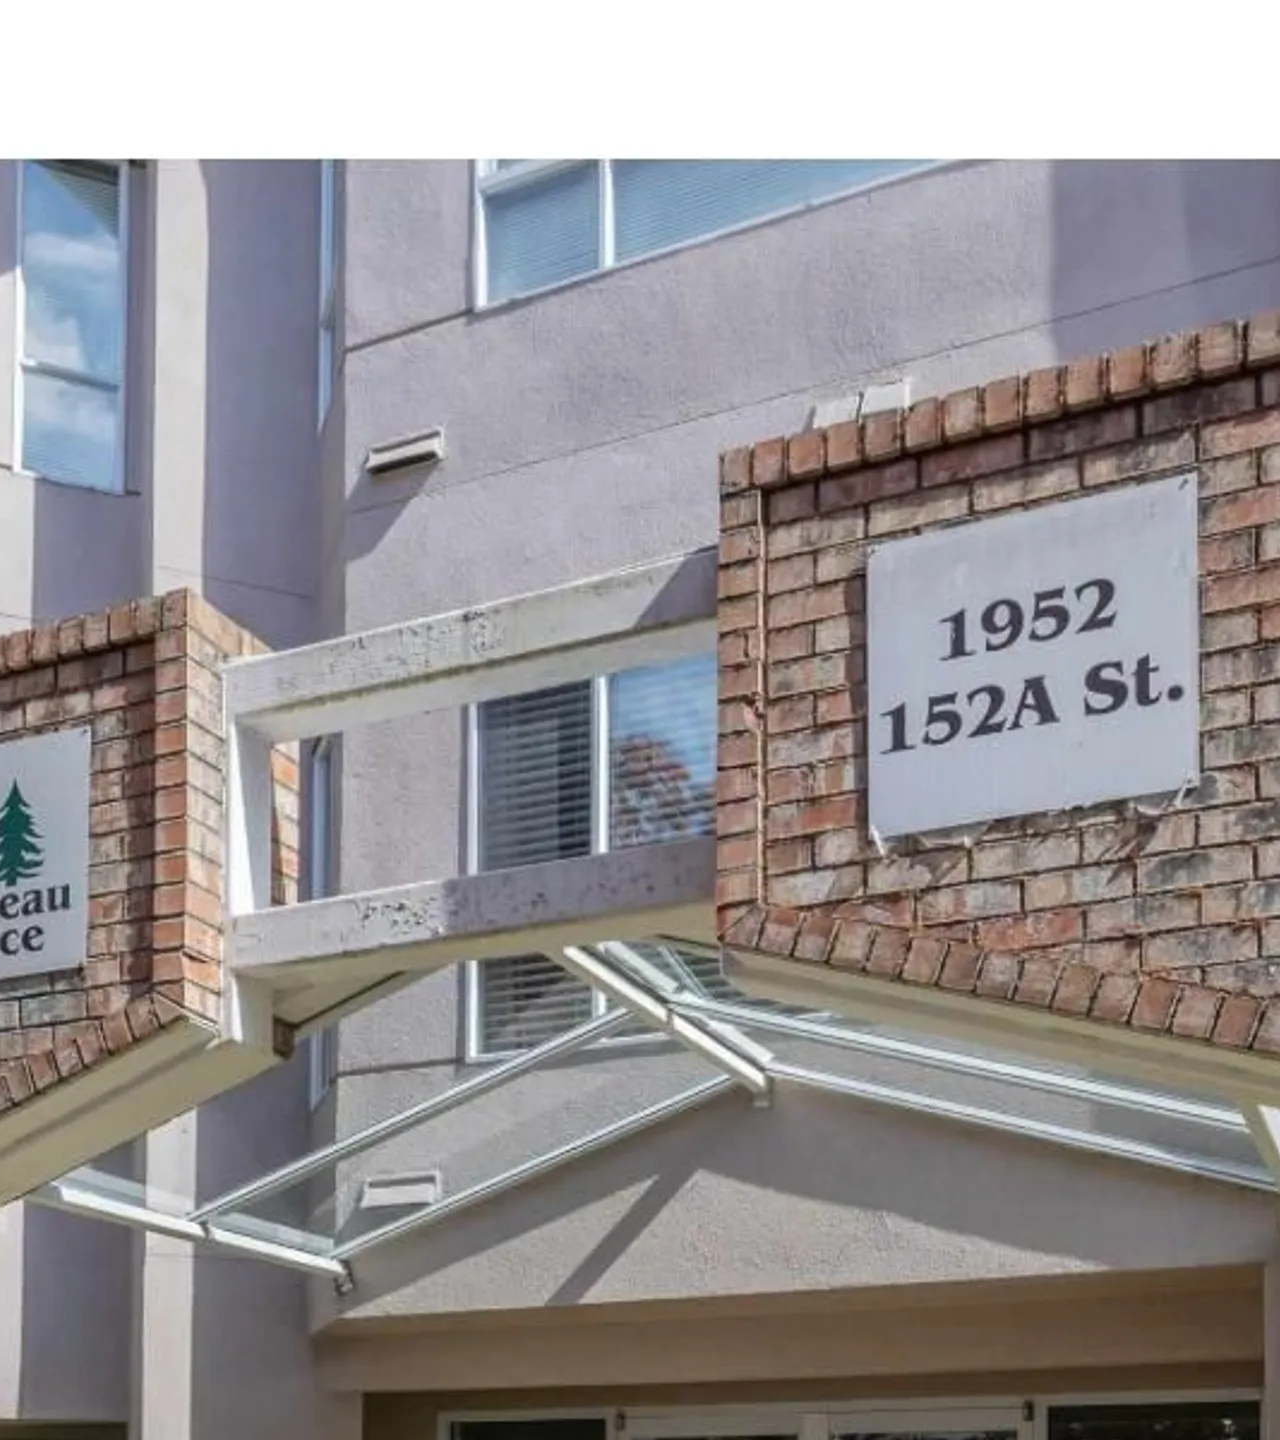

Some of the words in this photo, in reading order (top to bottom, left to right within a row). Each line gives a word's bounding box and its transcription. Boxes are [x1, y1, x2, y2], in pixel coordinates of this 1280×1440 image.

[938, 578, 1117, 661] 1952
[880, 675, 1060, 755] 152A
[1083, 653, 1184, 716] St.
